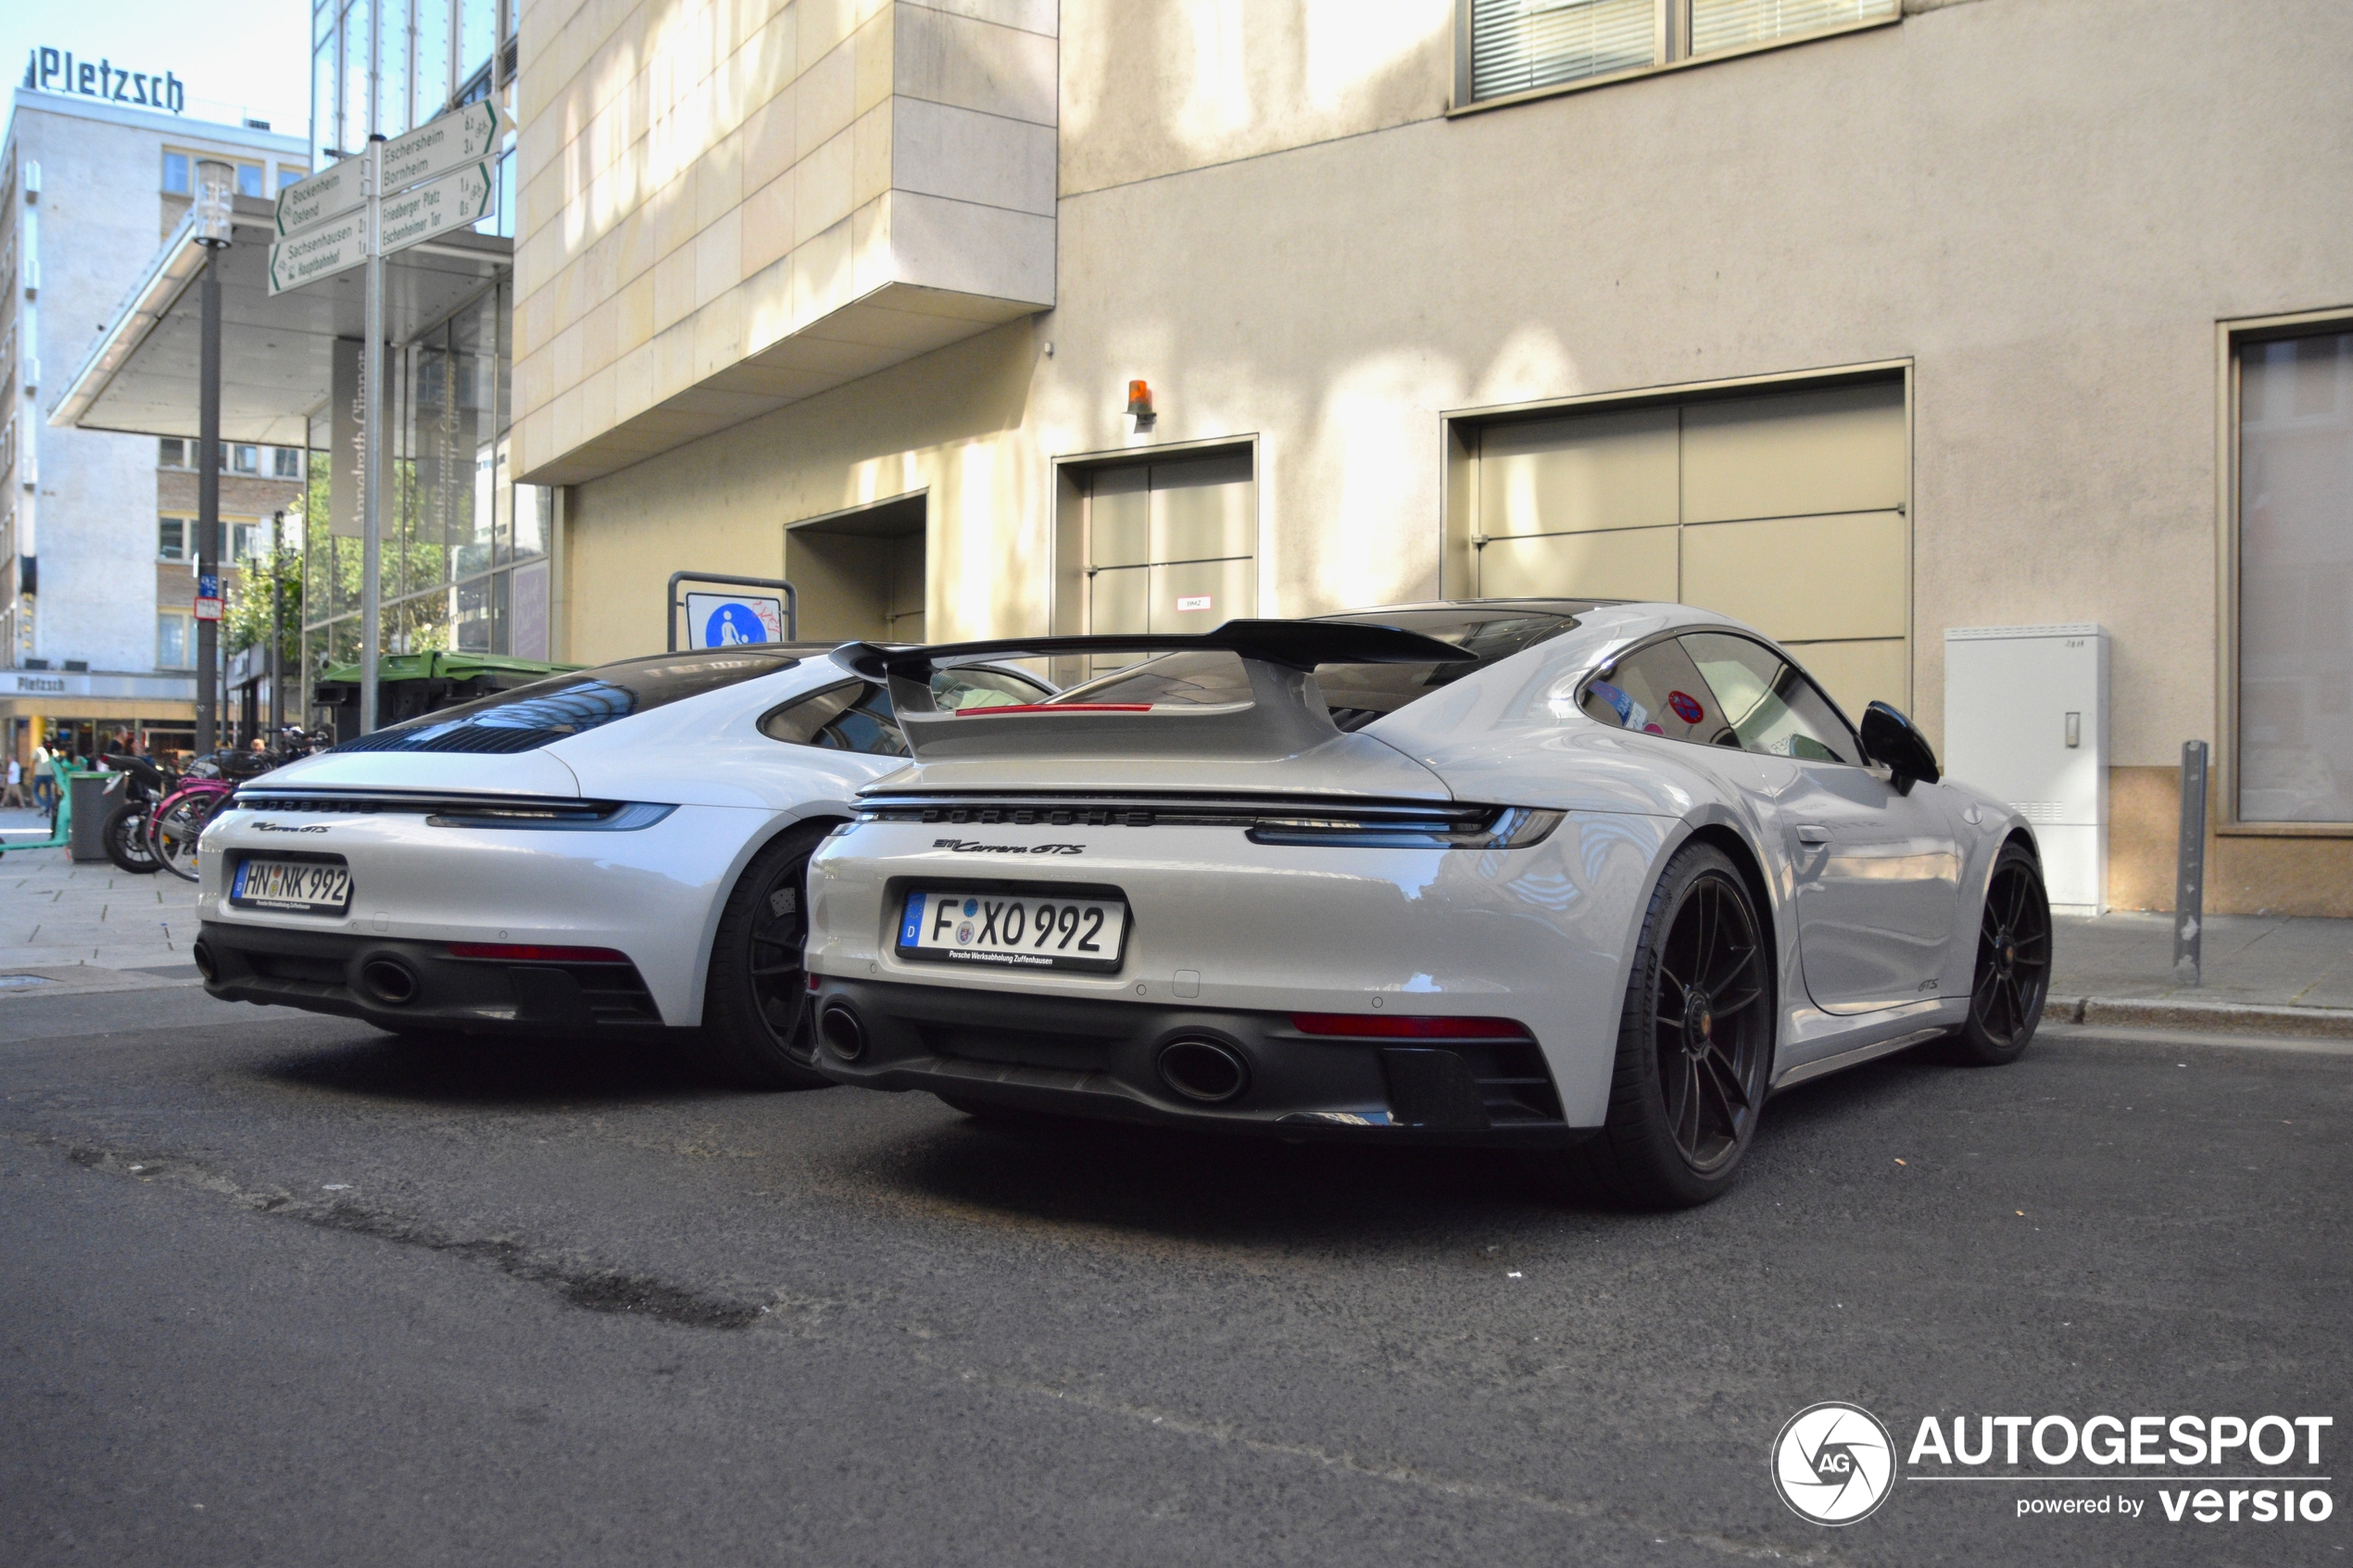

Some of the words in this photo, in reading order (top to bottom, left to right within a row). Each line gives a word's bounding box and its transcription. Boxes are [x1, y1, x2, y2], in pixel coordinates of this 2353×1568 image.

[40, 46, 183, 111] Pletzsch
[384, 129, 445, 165] Eschersheim
[384, 158, 429, 186] Bornheim
[292, 174, 340, 205] Bockenheim
[292, 201, 320, 225] Ostend
[383, 199, 421, 223] Friedberger
[423, 190, 441, 208] Platz
[288, 226, 352, 259] Sachsenhausen
[383, 218, 427, 246] Eschenheimer
[431, 211, 442, 227] Tor
[299, 825, 332, 834] GTS
[922, 809, 1151, 827] PORSCHE
[951, 841, 1027, 853] Carrera
[1030, 844, 1087, 855] GTS
[244, 864, 273, 896] HN
[279, 866, 309, 898] NK
[308, 868, 349, 902] 992
[907, 926, 915, 938] D
[932, 899, 960, 942] F
[977, 901, 1026, 947] XO
[1034, 904, 1105, 952] 992
[949, 950, 971, 960] Porsche
[971, 952, 1013, 963] Werksabholung
[1013, 955, 1053, 965] Zuffenhausen
[1918, 978, 1939, 992] GTS
